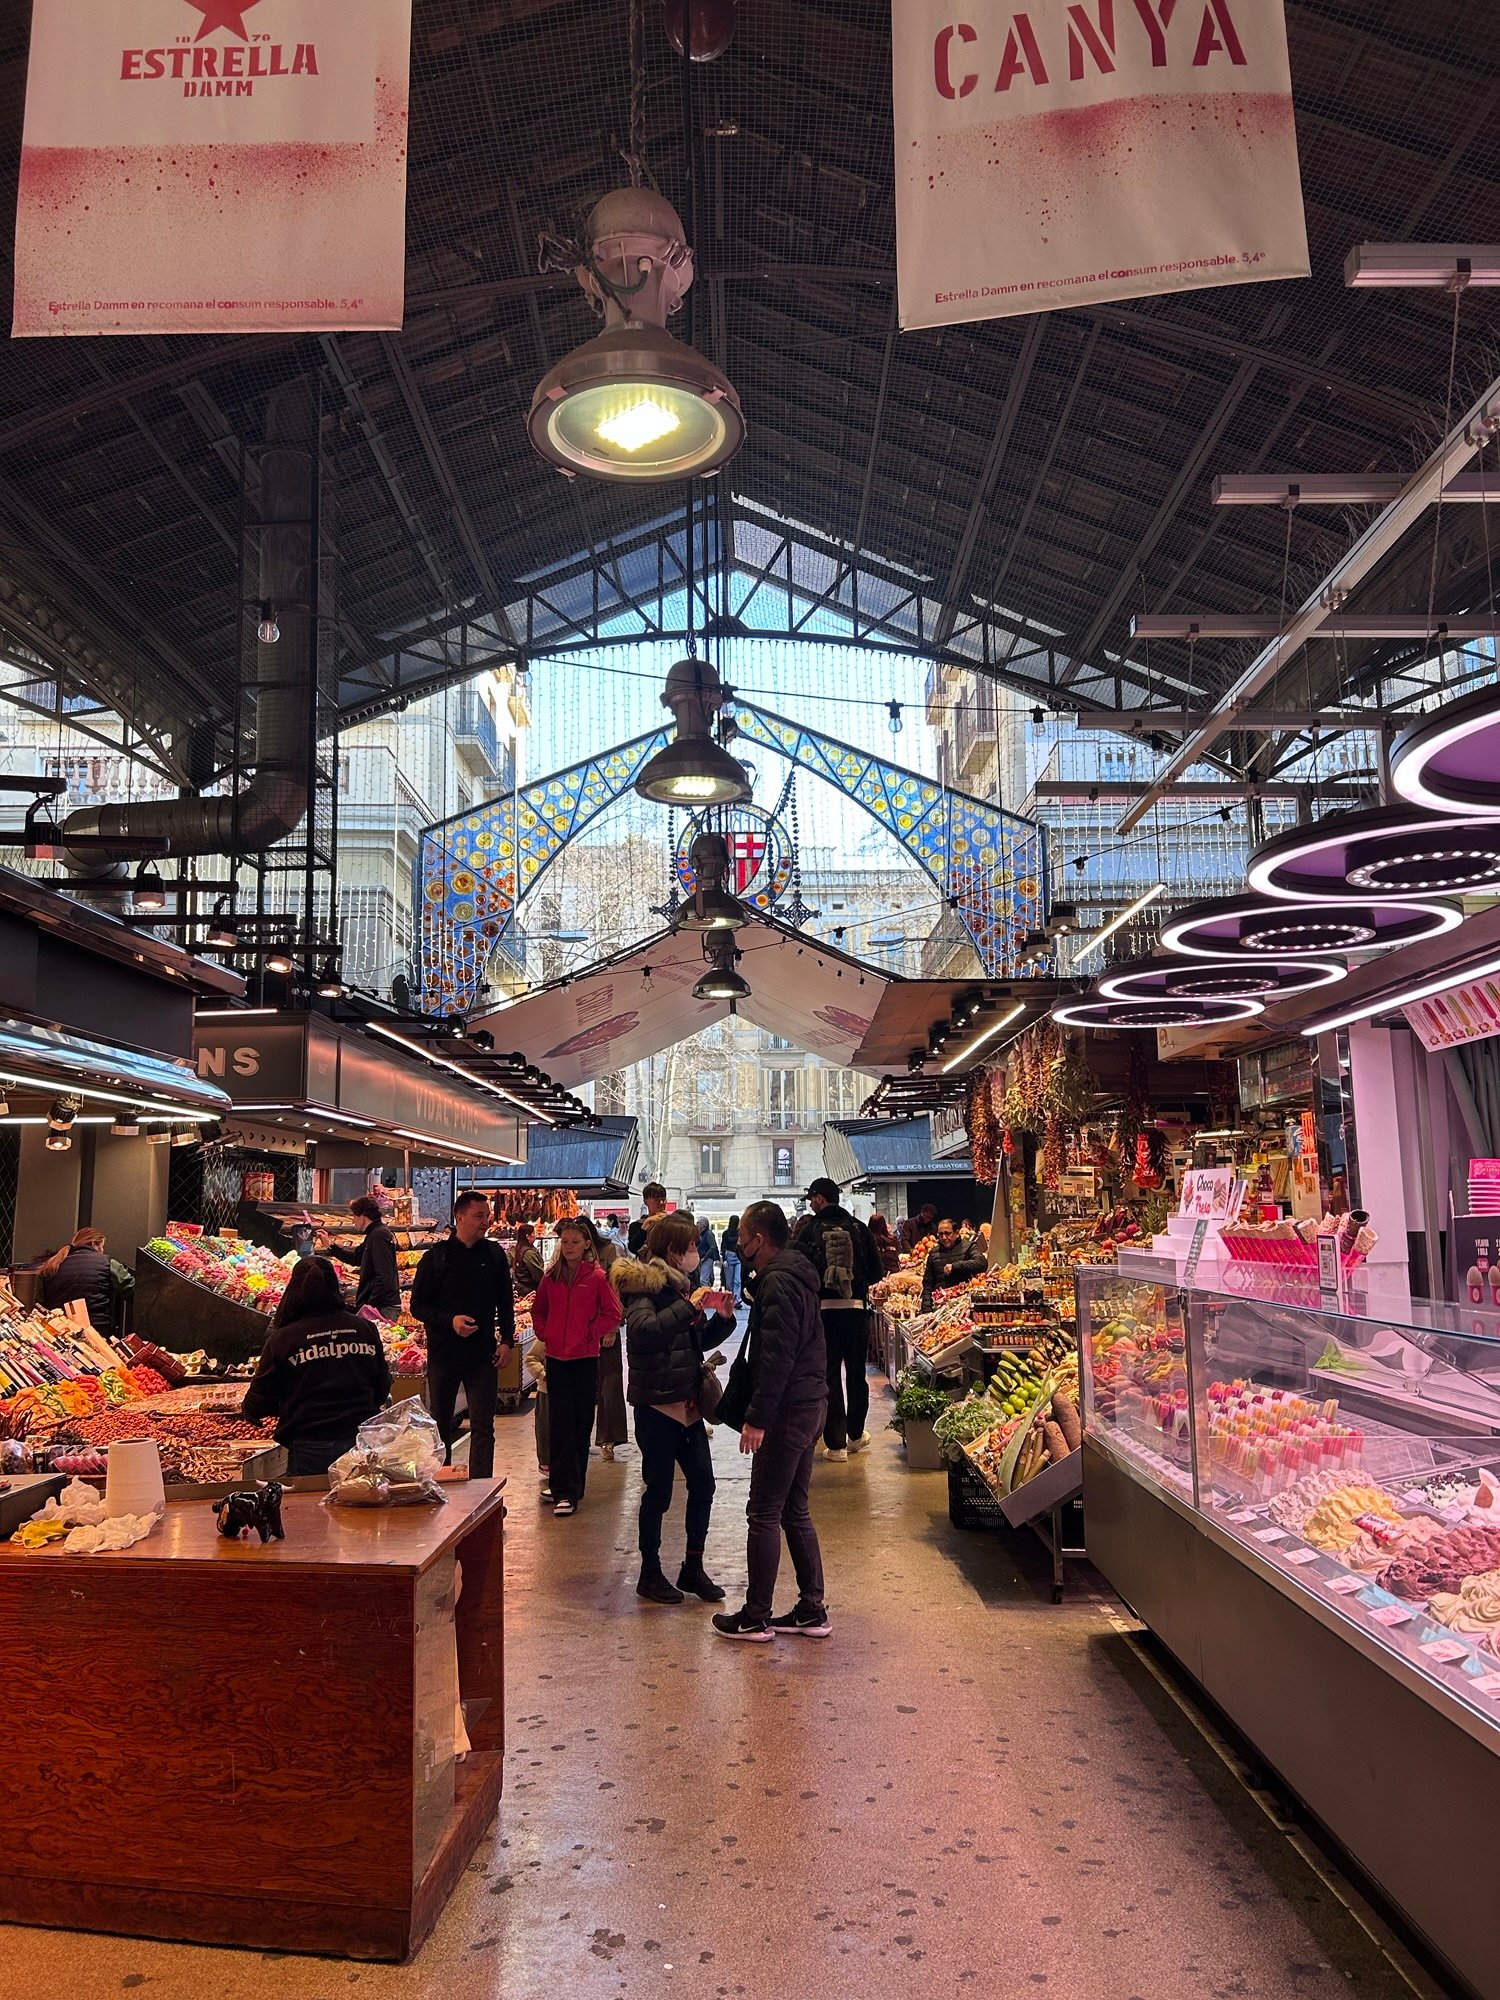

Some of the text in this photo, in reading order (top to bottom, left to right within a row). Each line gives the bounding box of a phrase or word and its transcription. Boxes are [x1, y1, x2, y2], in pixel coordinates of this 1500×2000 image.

[175, 36, 191, 44] 18
[934, 0, 1248, 100] CANYA
[120, 44, 319, 80] ESTRELLA
[183, 81, 253, 97] DAMM
[936, 289, 979, 304] Estrella
[981, 284, 1018, 297] Damm
[1020, 281, 1035, 291] en
[1037, 273, 1097, 290] recomana
[1098, 269, 1109, 280] el
[1111, 266, 1157, 279] consum
[1160, 255, 1240, 273] responsable.
[48, 301, 91, 312] Estrella
[94, 300, 129, 310] Damm
[147, 300, 204, 310] recomana
[205, 299, 216, 309] el
[217, 300, 262, 309] consum
[264, 299, 338, 311] responsable.
[415, 1085, 479, 1136] VIDAL PONS
[288, 1342, 377, 1367] vidalpons
